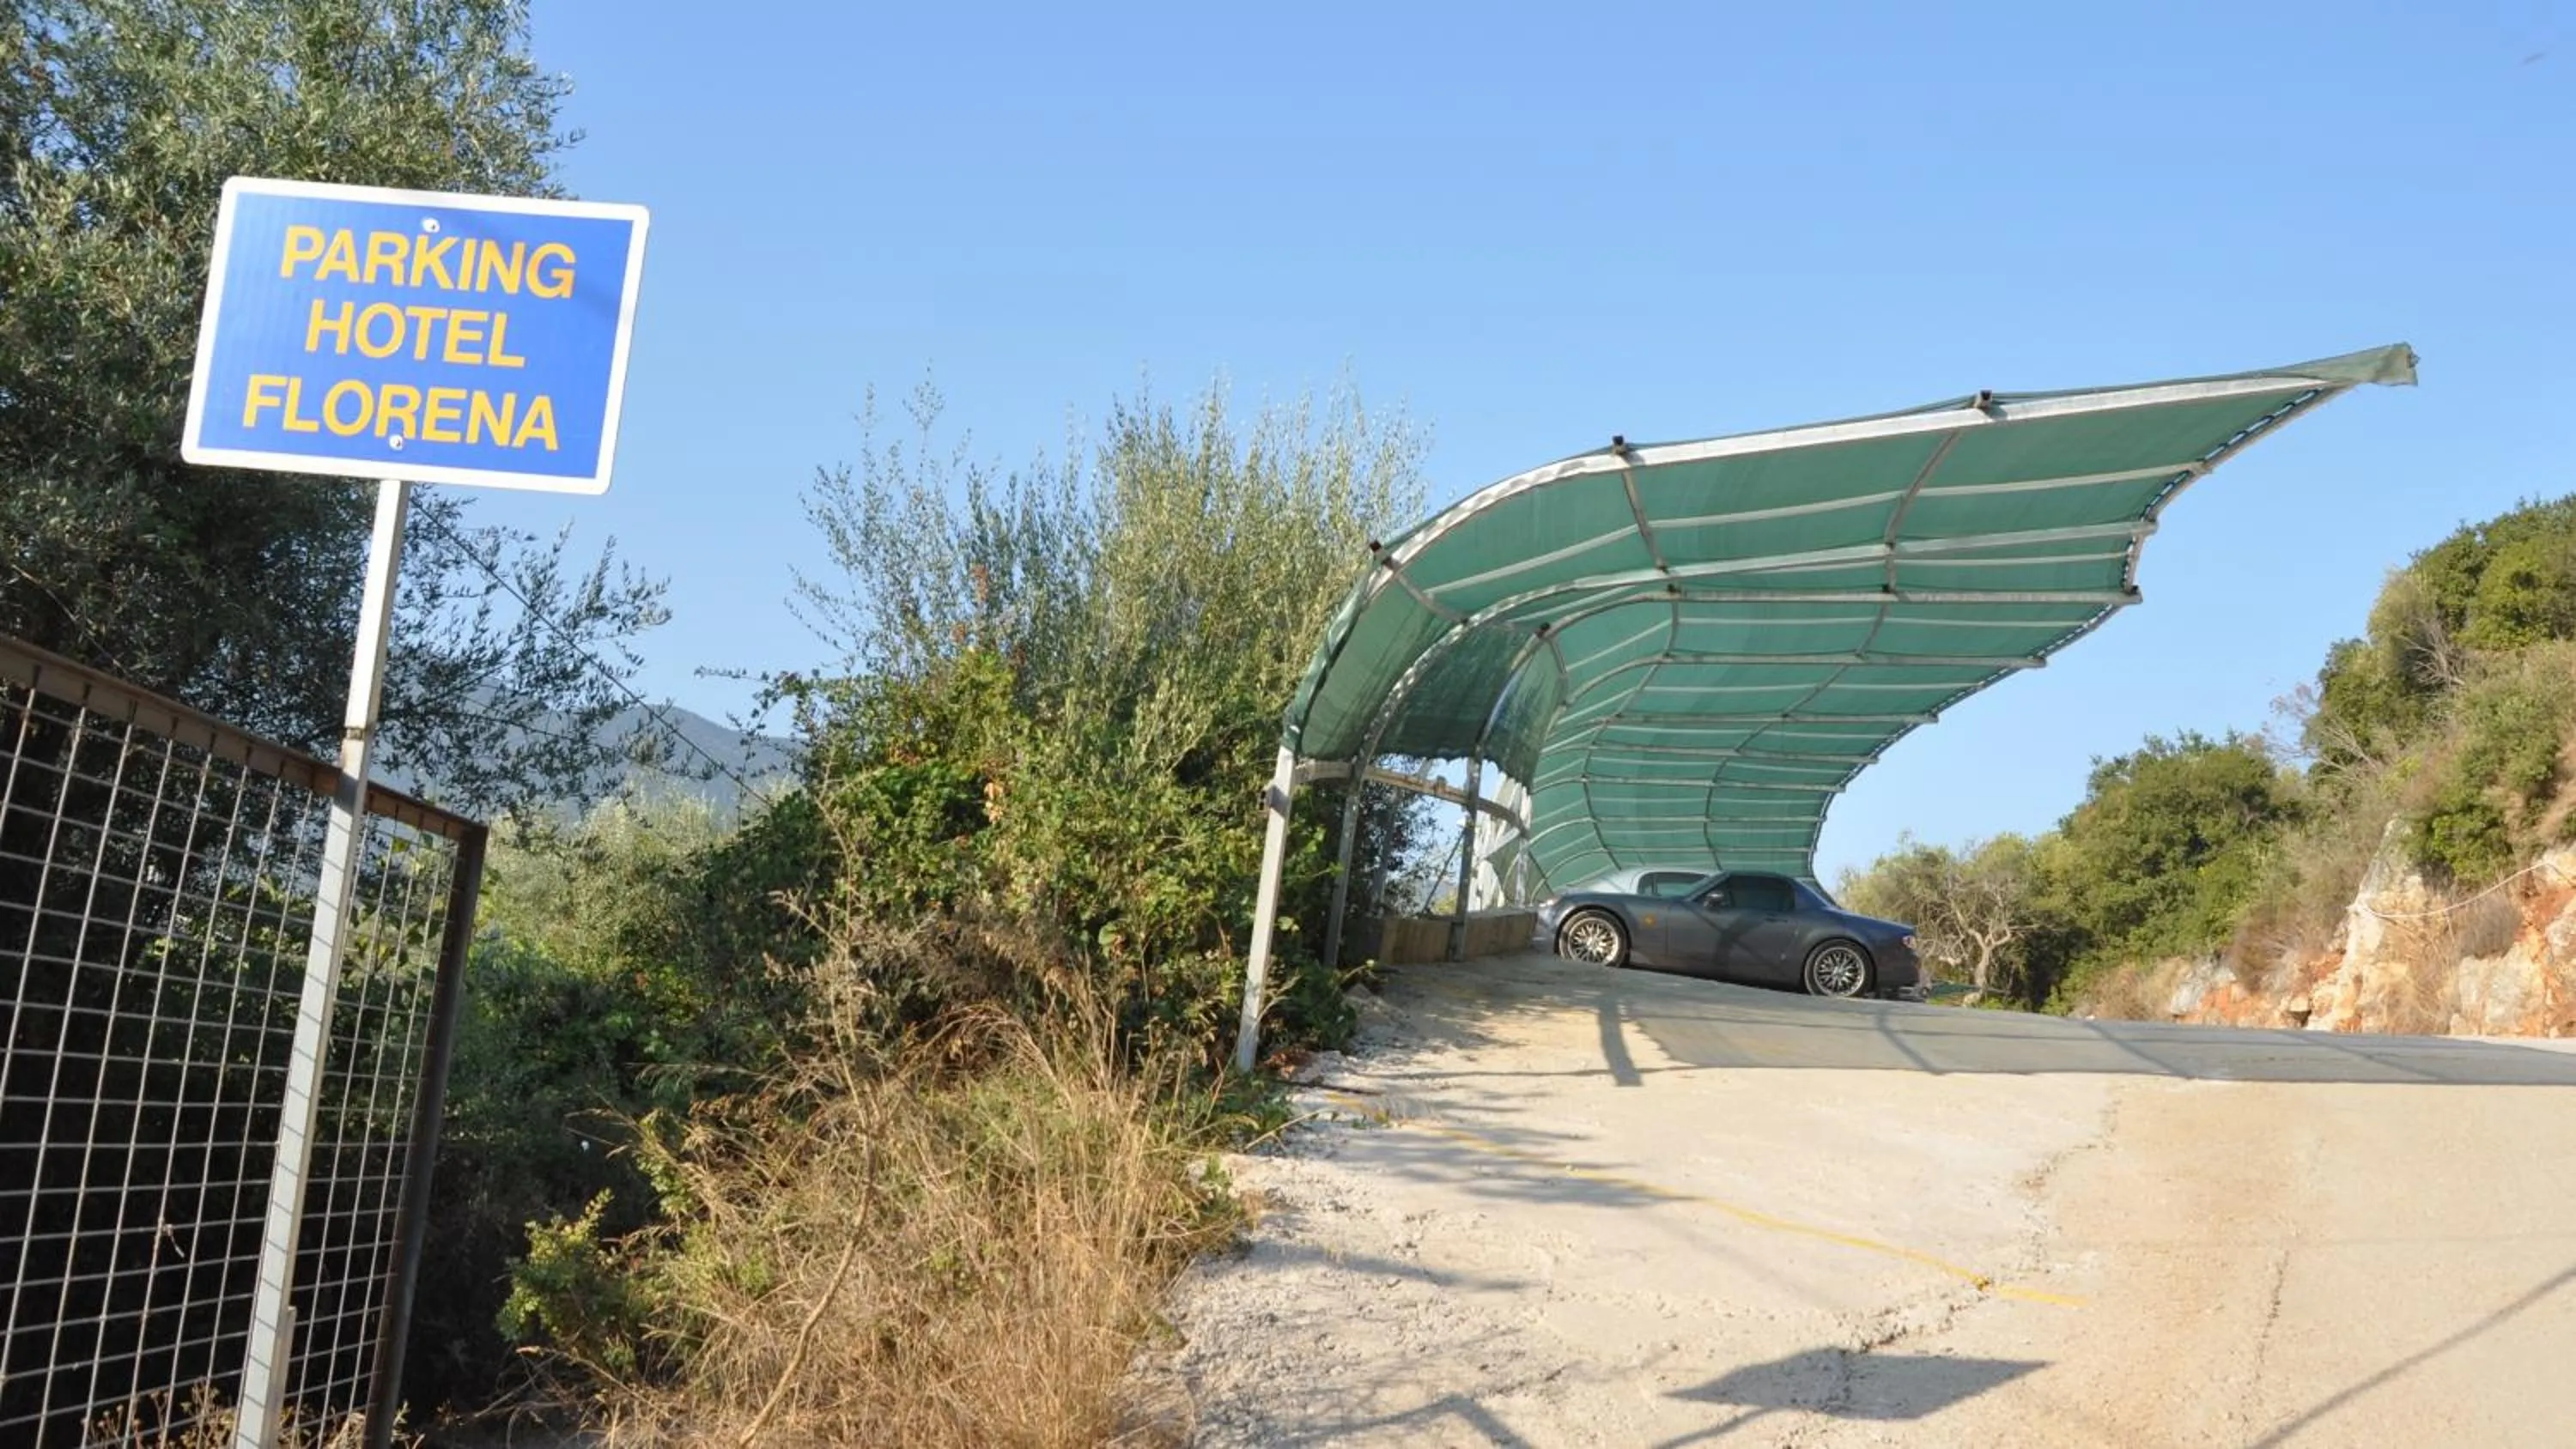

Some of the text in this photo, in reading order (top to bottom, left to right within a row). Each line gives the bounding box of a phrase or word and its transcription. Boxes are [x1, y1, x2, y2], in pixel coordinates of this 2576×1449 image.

[280, 225, 575, 299] PARKING
[306, 299, 524, 367] HOTEL
[242, 374, 559, 451] FLORENA
